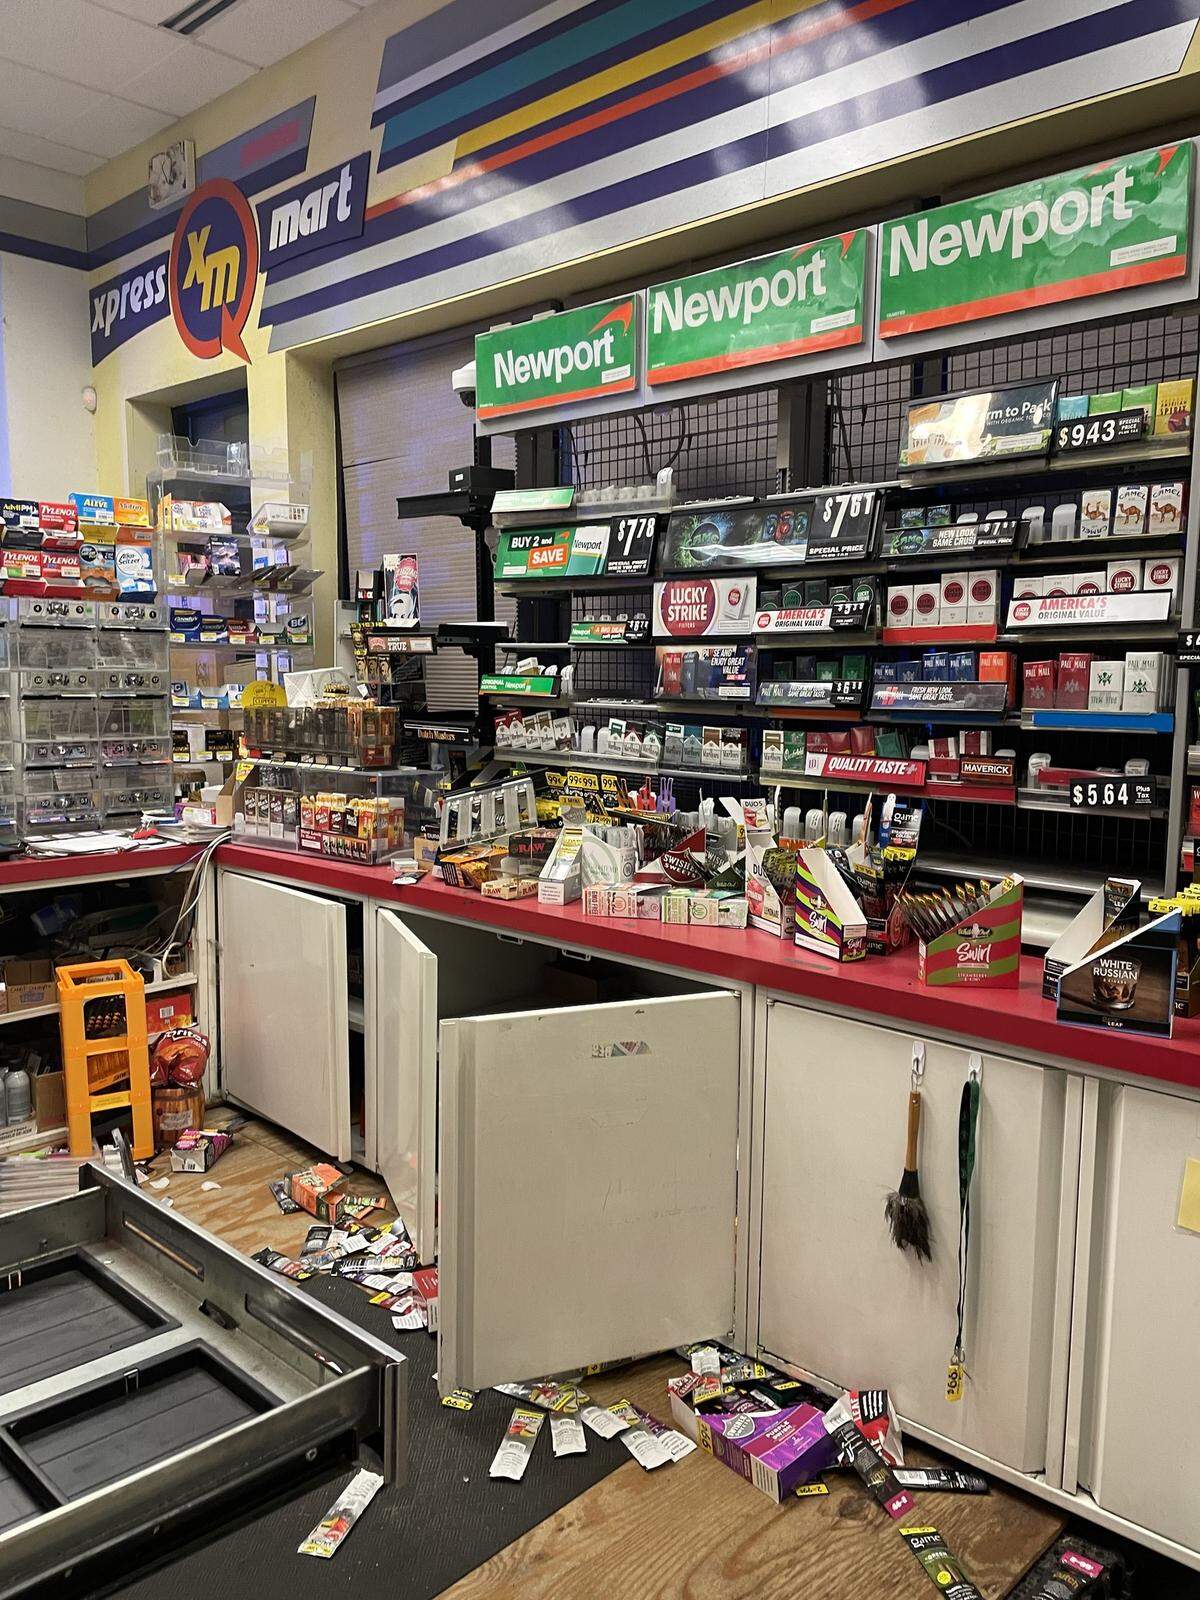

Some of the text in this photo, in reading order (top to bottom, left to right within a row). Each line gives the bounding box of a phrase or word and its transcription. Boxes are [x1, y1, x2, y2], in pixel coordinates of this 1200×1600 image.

[268, 163, 352, 251] mart
[889, 167, 1136, 278] Newport
[91, 263, 167, 337] xpress
[652, 253, 828, 336] Newport
[493, 329, 615, 389] Newport
[986, 409, 1003, 420] rm
[1006, 407, 1019, 417] to
[1118, 418, 1140, 426] SPECIAL
[1121, 424, 1137, 432] PRICE
[1118, 490, 1146, 500] CAMEL
[1152, 488, 1181, 498] CAMEL
[41, 505, 76, 516] TYLENOL
[938, 529, 955, 537] NEW
[511, 536, 553, 549] BUY 2 and
[573, 539, 602, 552] Newport
[933, 539, 953, 547] SAME
[809, 544, 864, 555] SPECIAL PRICE
[3, 551, 39, 562] TYLENOL
[42, 554, 79, 565] TYLENOL
[532, 549, 564, 564] SAVE
[1115, 576, 1133, 584] LUCKY
[670, 587, 707, 603] LUCKY
[1039, 597, 1108, 611] AMERICA'S
[668, 603, 707, 622] STRIKE
[777, 609, 826, 621] AMERICA'S
[1038, 609, 1105, 620] ORIGINAL VALUE
[804, 619, 823, 627] VALUE
[388, 642, 406, 651] TRUE
[711, 657, 744, 666] ENJOY GREAT
[1060, 660, 1087, 669] PALL MALL
[1128, 658, 1156, 668] PALL MALL
[723, 666, 739, 674] VALUE
[1025, 667, 1050, 678] PALL MALL
[418, 729, 433, 739] Dutch
[828, 757, 870, 773] QUALITY
[964, 764, 1009, 774] MAVERICK
[569, 775, 582, 784] 99¢
[583, 778, 597, 786] 99¢
[1136, 785, 1150, 793] Plus
[893, 812, 919, 825] game
[521, 843, 545, 852] RAW
[706, 851, 725, 866] WISH
[522, 884, 537, 894] RAW
[867, 941, 883, 951] ame
[956, 943, 992, 963] Swirl
[1100, 958, 1133, 971] WHITE
[1093, 967, 1139, 981] RUSSIAN
[851, 1398, 861, 1422] LEAF
[766, 1420, 790, 1438] PURPLE
[910, 1535, 940, 1548] game
